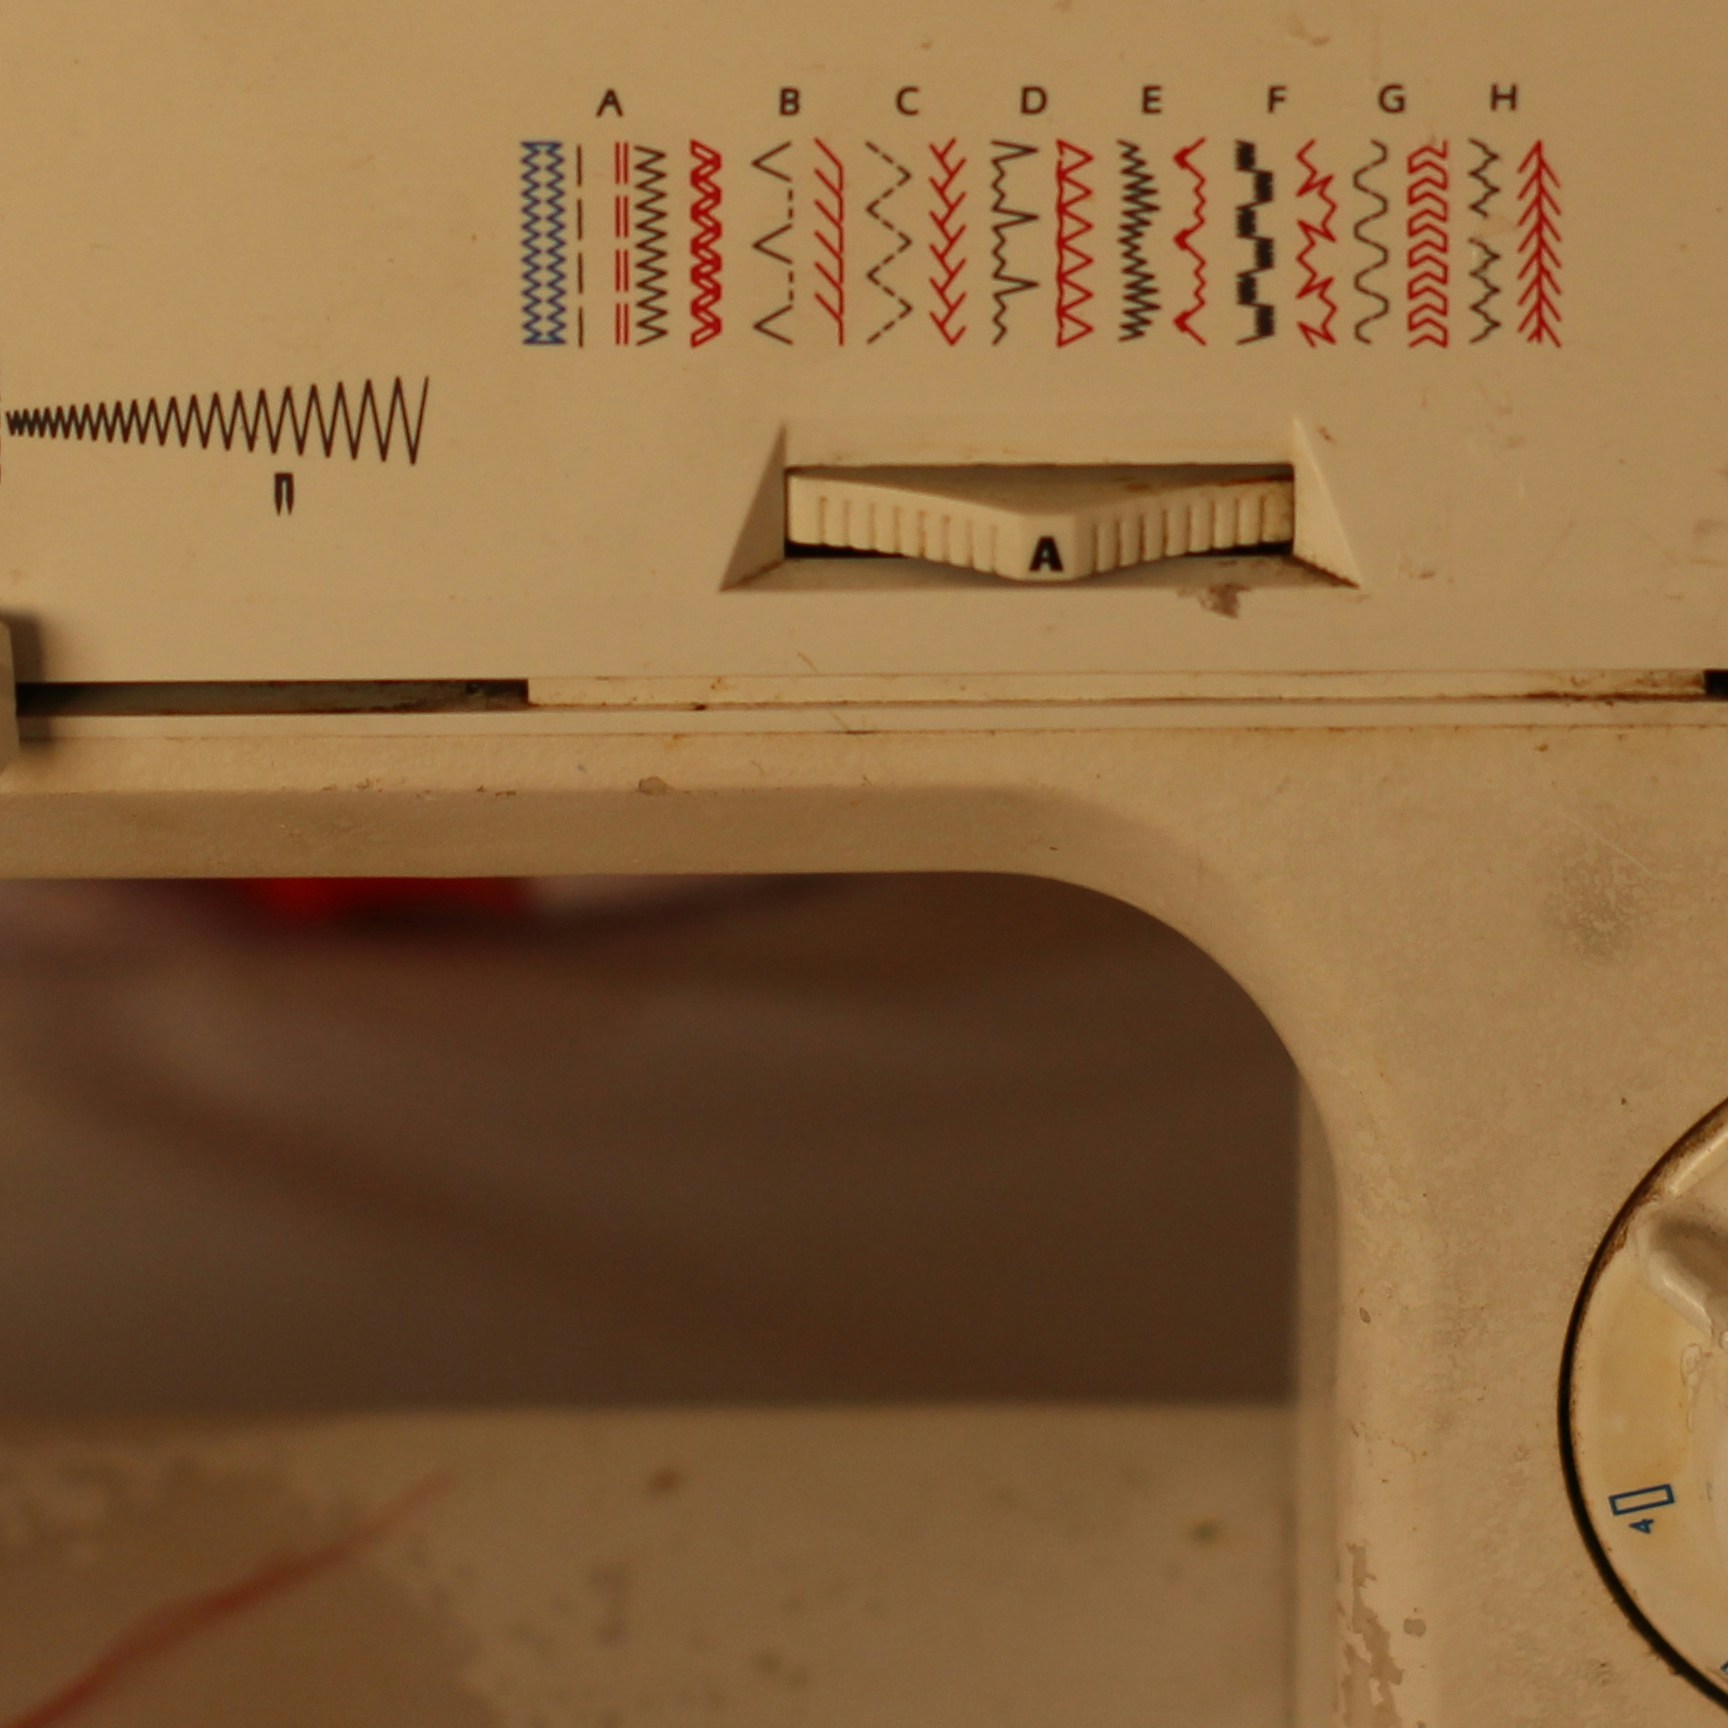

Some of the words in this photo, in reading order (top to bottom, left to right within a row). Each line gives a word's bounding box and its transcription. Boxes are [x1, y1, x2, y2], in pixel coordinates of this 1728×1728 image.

[595, 88, 624, 118] A
[779, 87, 801, 117] B
[895, 86, 919, 117] C
[1020, 85, 1048, 115] D
[1141, 84, 1162, 115] E
[1267, 85, 1287, 114] F
[1378, 83, 1406, 114] G
[1490, 83, 1518, 111] H
[1028, 535, 1064, 573] A
